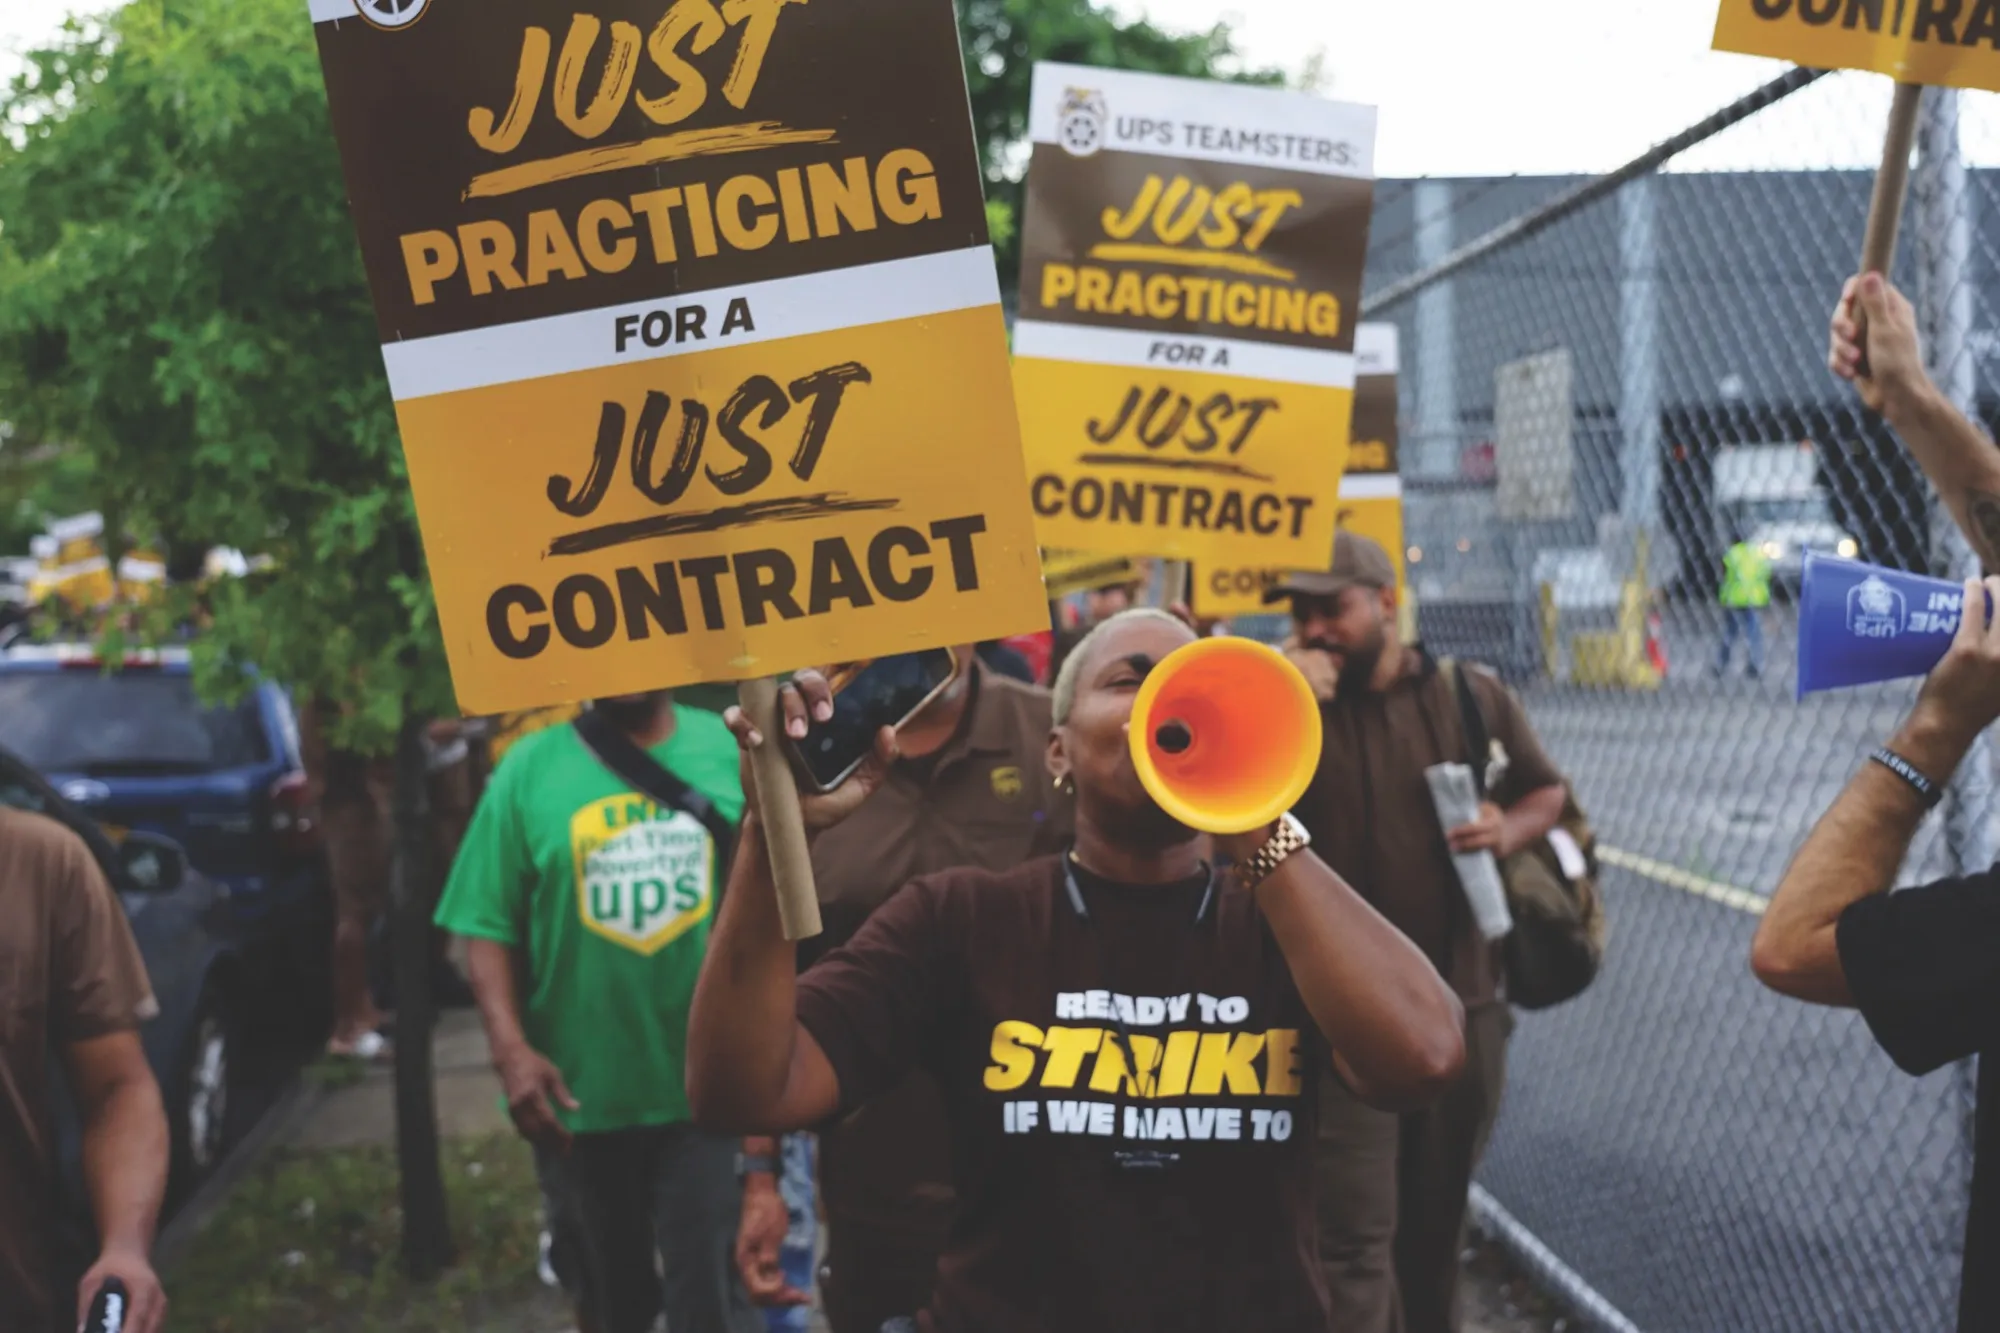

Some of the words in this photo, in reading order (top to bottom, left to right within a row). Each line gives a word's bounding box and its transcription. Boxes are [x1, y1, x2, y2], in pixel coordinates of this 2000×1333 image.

[468, 0, 808, 153] JUST
[1115, 115, 1174, 145] UPS
[400, 148, 941, 305] PRACTICING
[1101, 173, 1303, 253] JUST
[614, 303, 707, 352] FOR
[720, 297, 755, 336] A
[1040, 262, 1342, 337] PRACTICING
[1147, 341, 1205, 366] FOR
[1209, 349, 1231, 367] A
[547, 361, 872, 517] JUST
[1085, 385, 1281, 454] JUST
[1031, 474, 1313, 538] CONTRACT
[486, 514, 987, 660] CONTRACT
[1854, 621, 1896, 638] UPS
[1907, 610, 1960, 635] ME
[590, 873, 701, 931] ups
[1056, 990, 1191, 1025] READY
[1197, 992, 1249, 1024] TO
[983, 1020, 1301, 1099] STRIKE
[1003, 1100, 1038, 1134] IF
[1046, 1099, 1116, 1136] WE
[1123, 1105, 1241, 1140] HAVE
[1251, 1108, 1293, 1142] TO
